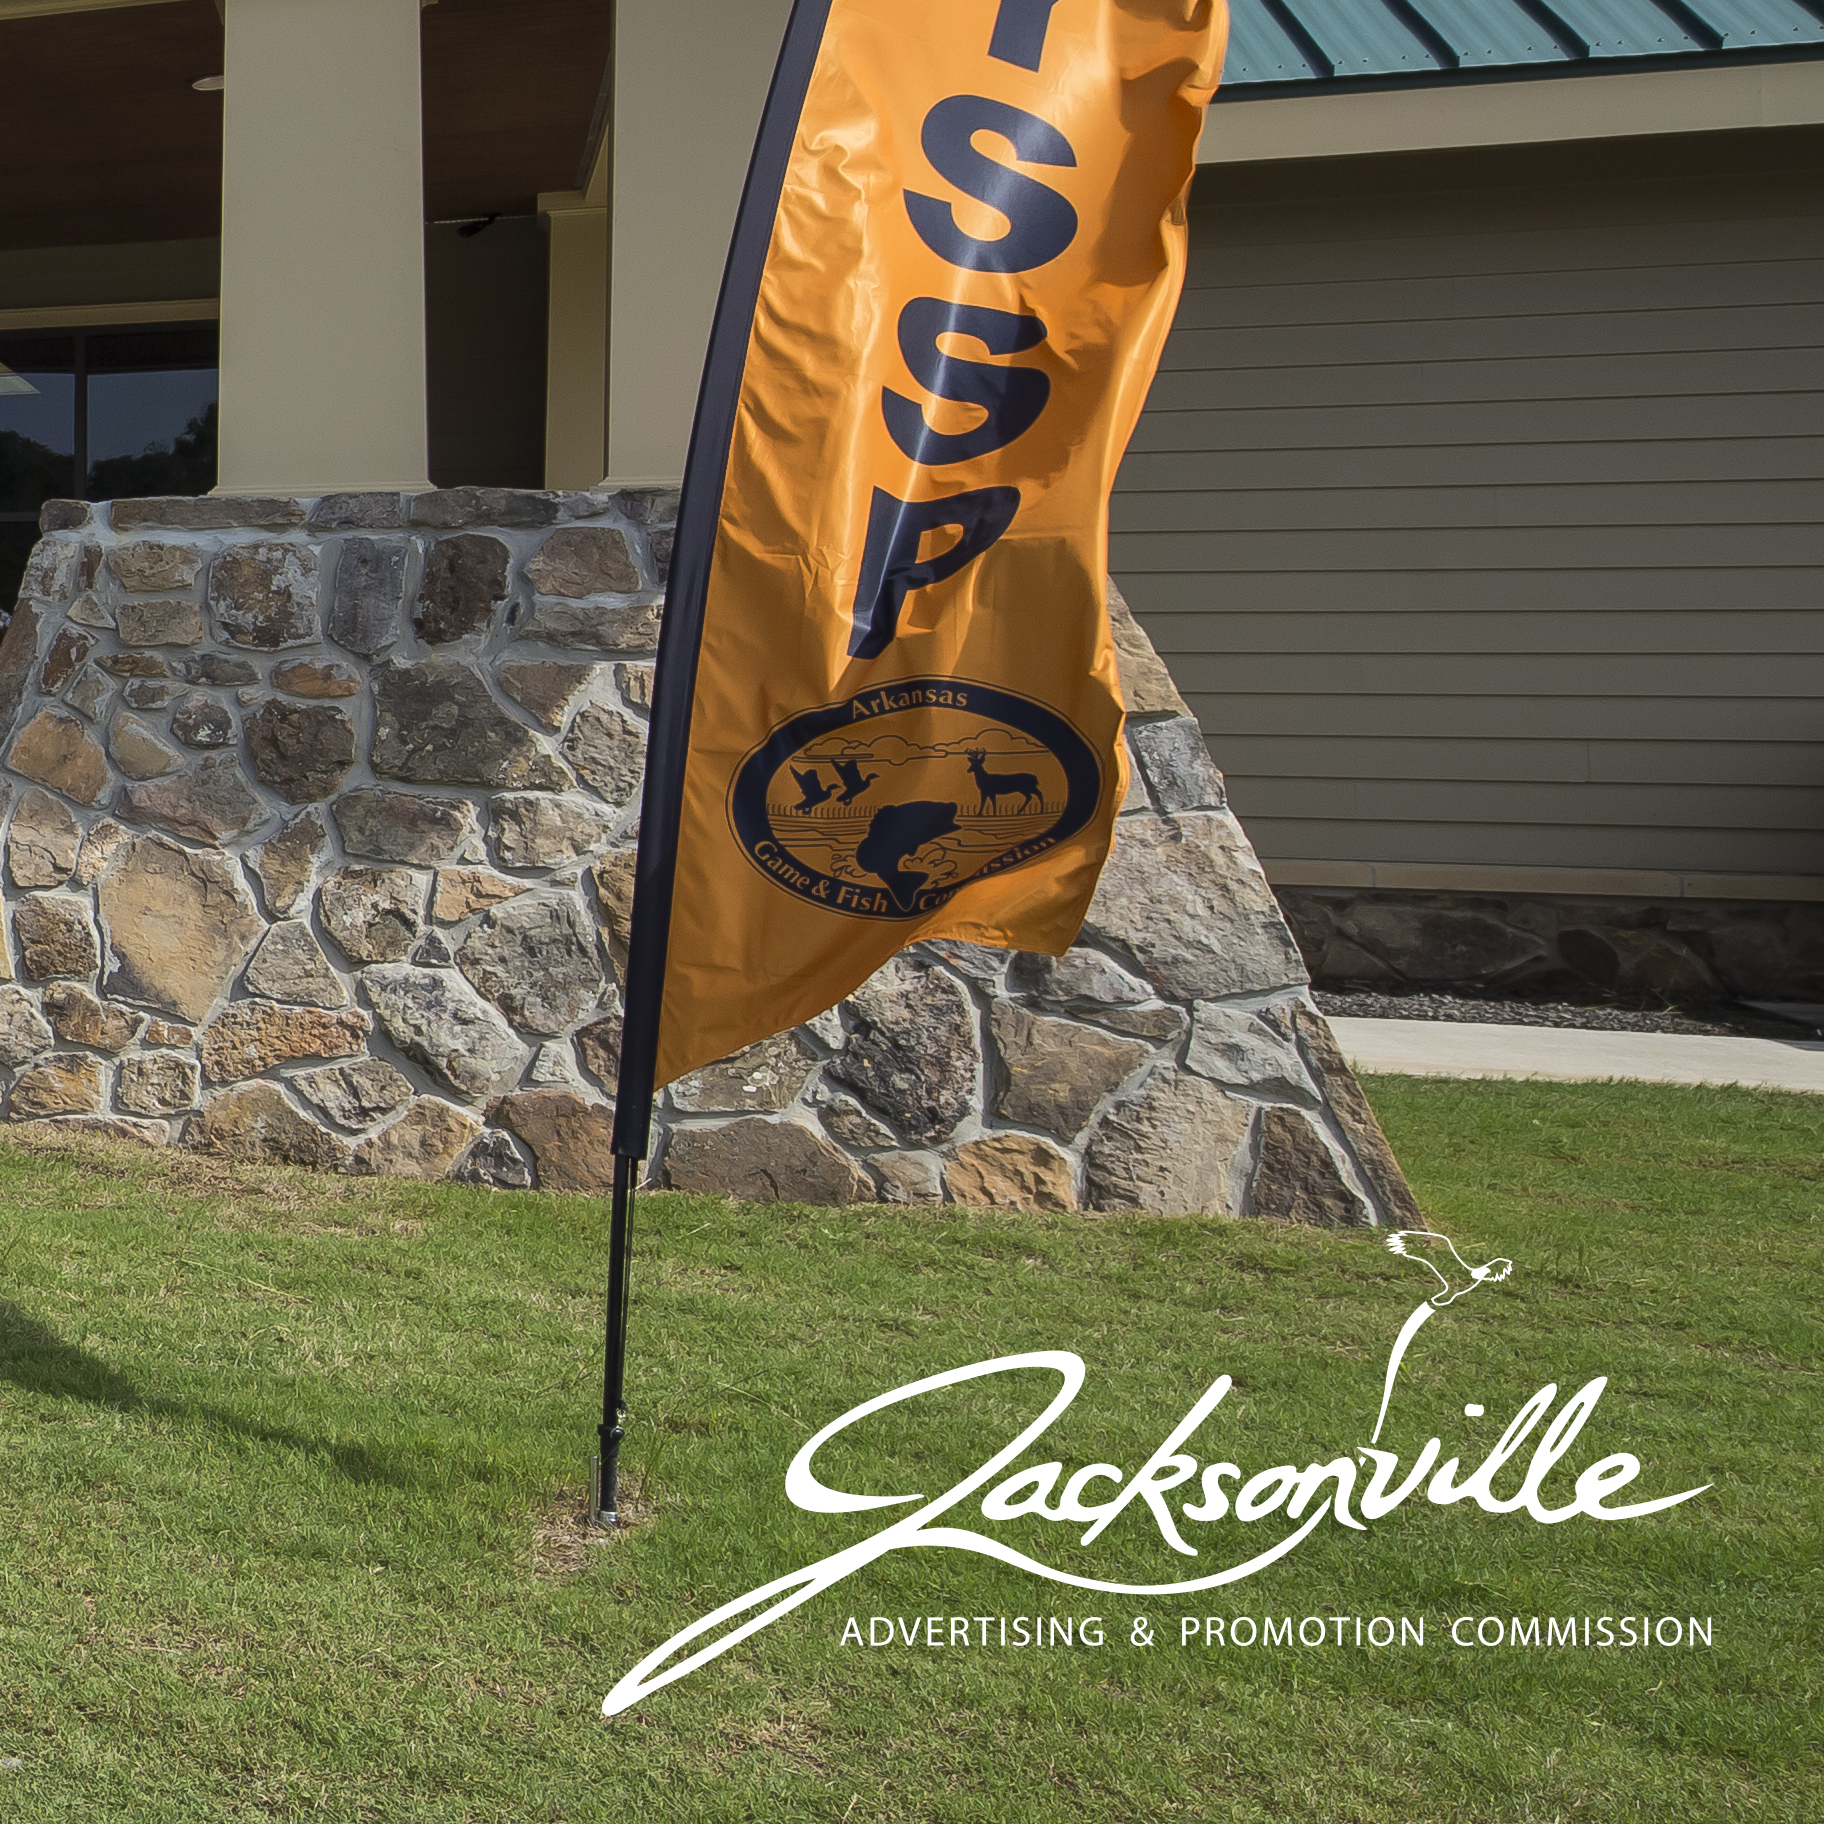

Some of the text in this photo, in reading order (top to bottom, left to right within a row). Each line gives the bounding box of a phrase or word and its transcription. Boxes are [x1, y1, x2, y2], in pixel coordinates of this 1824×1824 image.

[851, 688, 968, 720] Arkansas
[754, 836, 1057, 914] Game & Fish Coission
